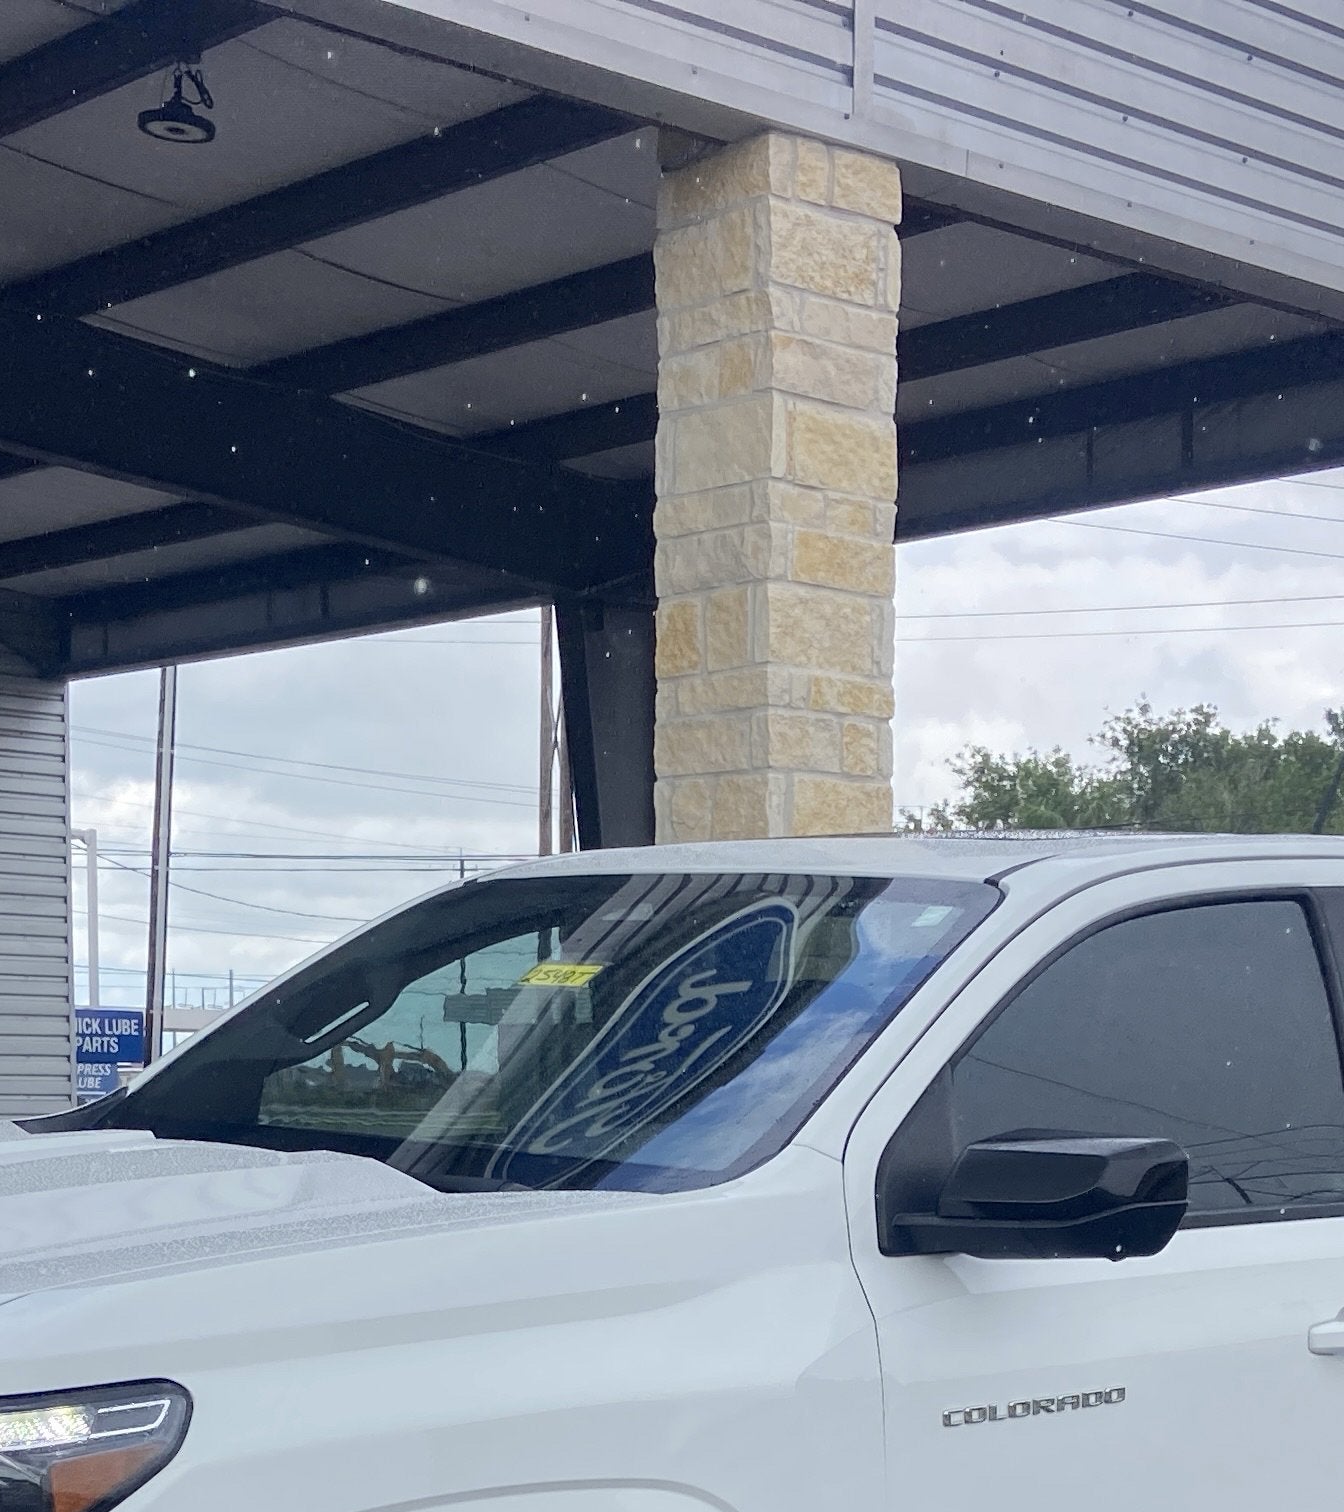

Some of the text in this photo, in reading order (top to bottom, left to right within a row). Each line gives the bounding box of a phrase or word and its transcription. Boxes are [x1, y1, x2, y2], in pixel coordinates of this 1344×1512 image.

[76, 1017, 139, 1036] ICK LUBE
[76, 1036, 119, 1053] PARTS
[76, 1077, 102, 1089] UBE
[942, 1387, 1126, 1428] COLORADO
